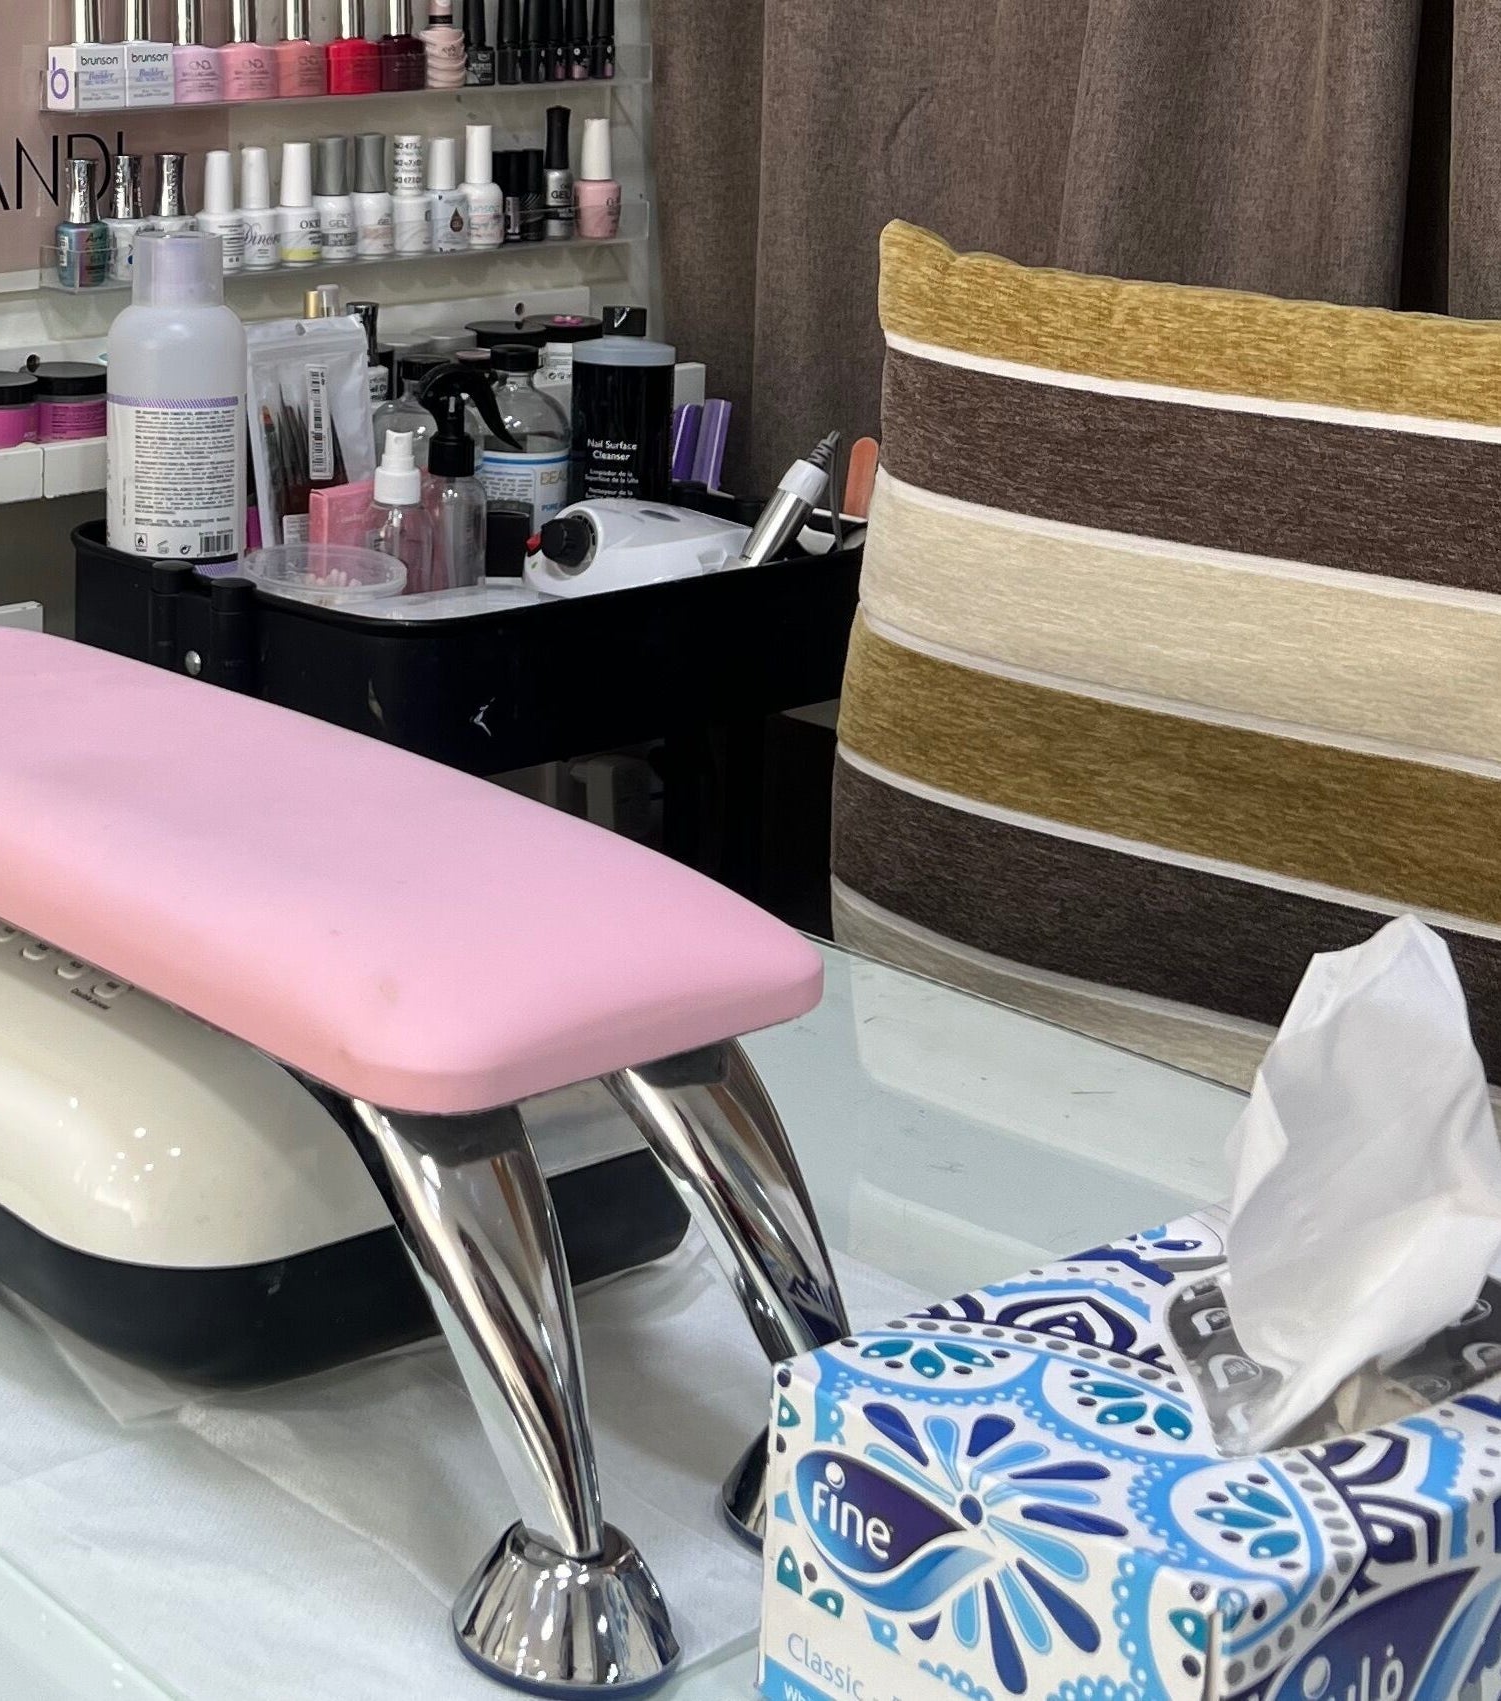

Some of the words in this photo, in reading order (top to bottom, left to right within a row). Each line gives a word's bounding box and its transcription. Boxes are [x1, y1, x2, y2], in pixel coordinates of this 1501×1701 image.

[80, 55, 119, 66] brunson
[131, 52, 169, 63] brunson
[587, 438, 603, 448] Nail
[605, 440, 638, 450] Surface
[592, 449, 630, 461] Cleanser
[787, 1632, 865, 1701] Classic
